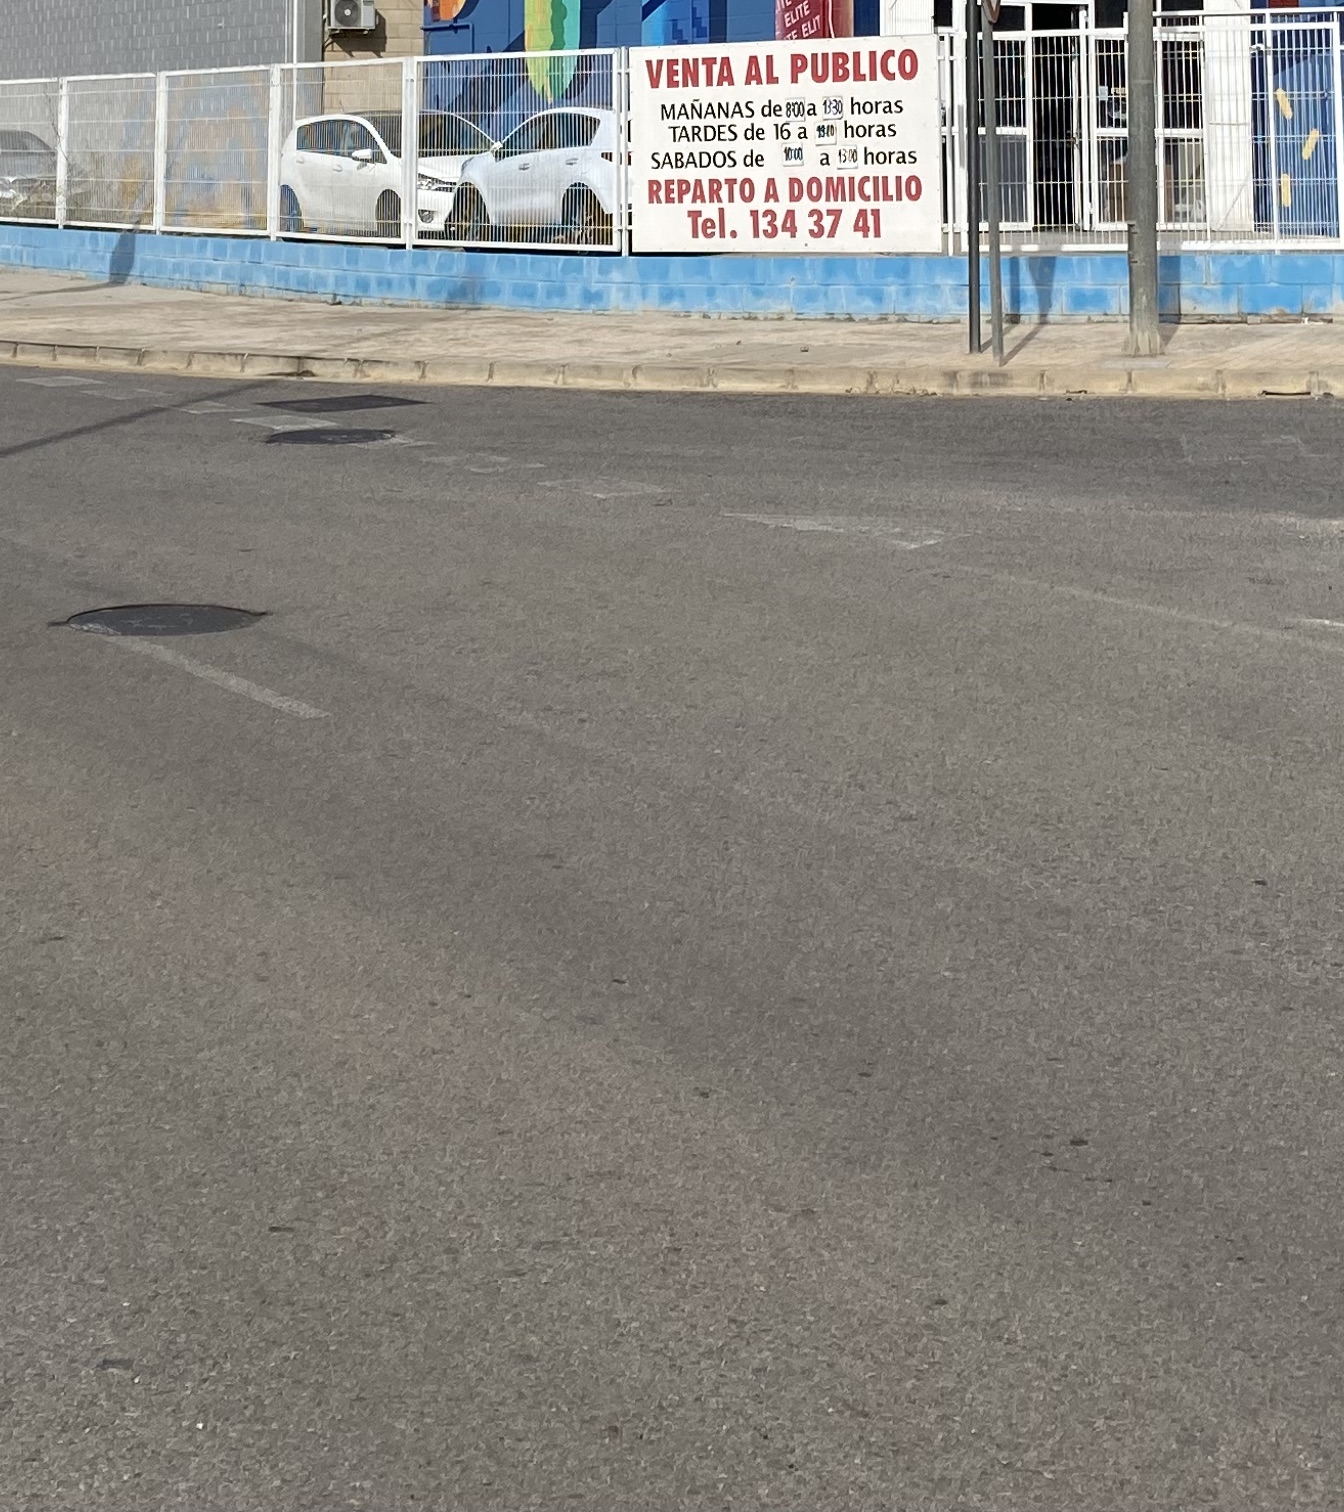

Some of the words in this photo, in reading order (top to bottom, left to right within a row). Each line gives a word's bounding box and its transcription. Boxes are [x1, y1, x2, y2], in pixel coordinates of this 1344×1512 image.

[784, 0, 811, 28] ELITE
[802, 14, 821, 39] ELIT
[645, 56, 735, 89] VENTA
[744, 54, 779, 86] AL
[791, 49, 919, 85] PUBLICO
[660, 98, 755, 121] MAÑANAS
[761, 99, 782, 118] de
[806, 102, 817, 116] a
[850, 96, 904, 116] horas
[668, 124, 738, 143] TARDES
[743, 122, 765, 140] de
[773, 123, 791, 140] 16
[797, 126, 808, 139] a
[844, 120, 897, 138] horas
[651, 150, 737, 169] SABADOS
[743, 149, 765, 168] de
[819, 152, 830, 166] a
[863, 146, 918, 165] horas
[647, 177, 755, 204] REPARTO
[764, 177, 780, 203] A
[788, 175, 923, 203] DOMICILIO
[687, 207, 738, 239] Tel.
[750, 209, 798, 239] 134
[808, 209, 843, 239] 37
[853, 208, 882, 239] 41
